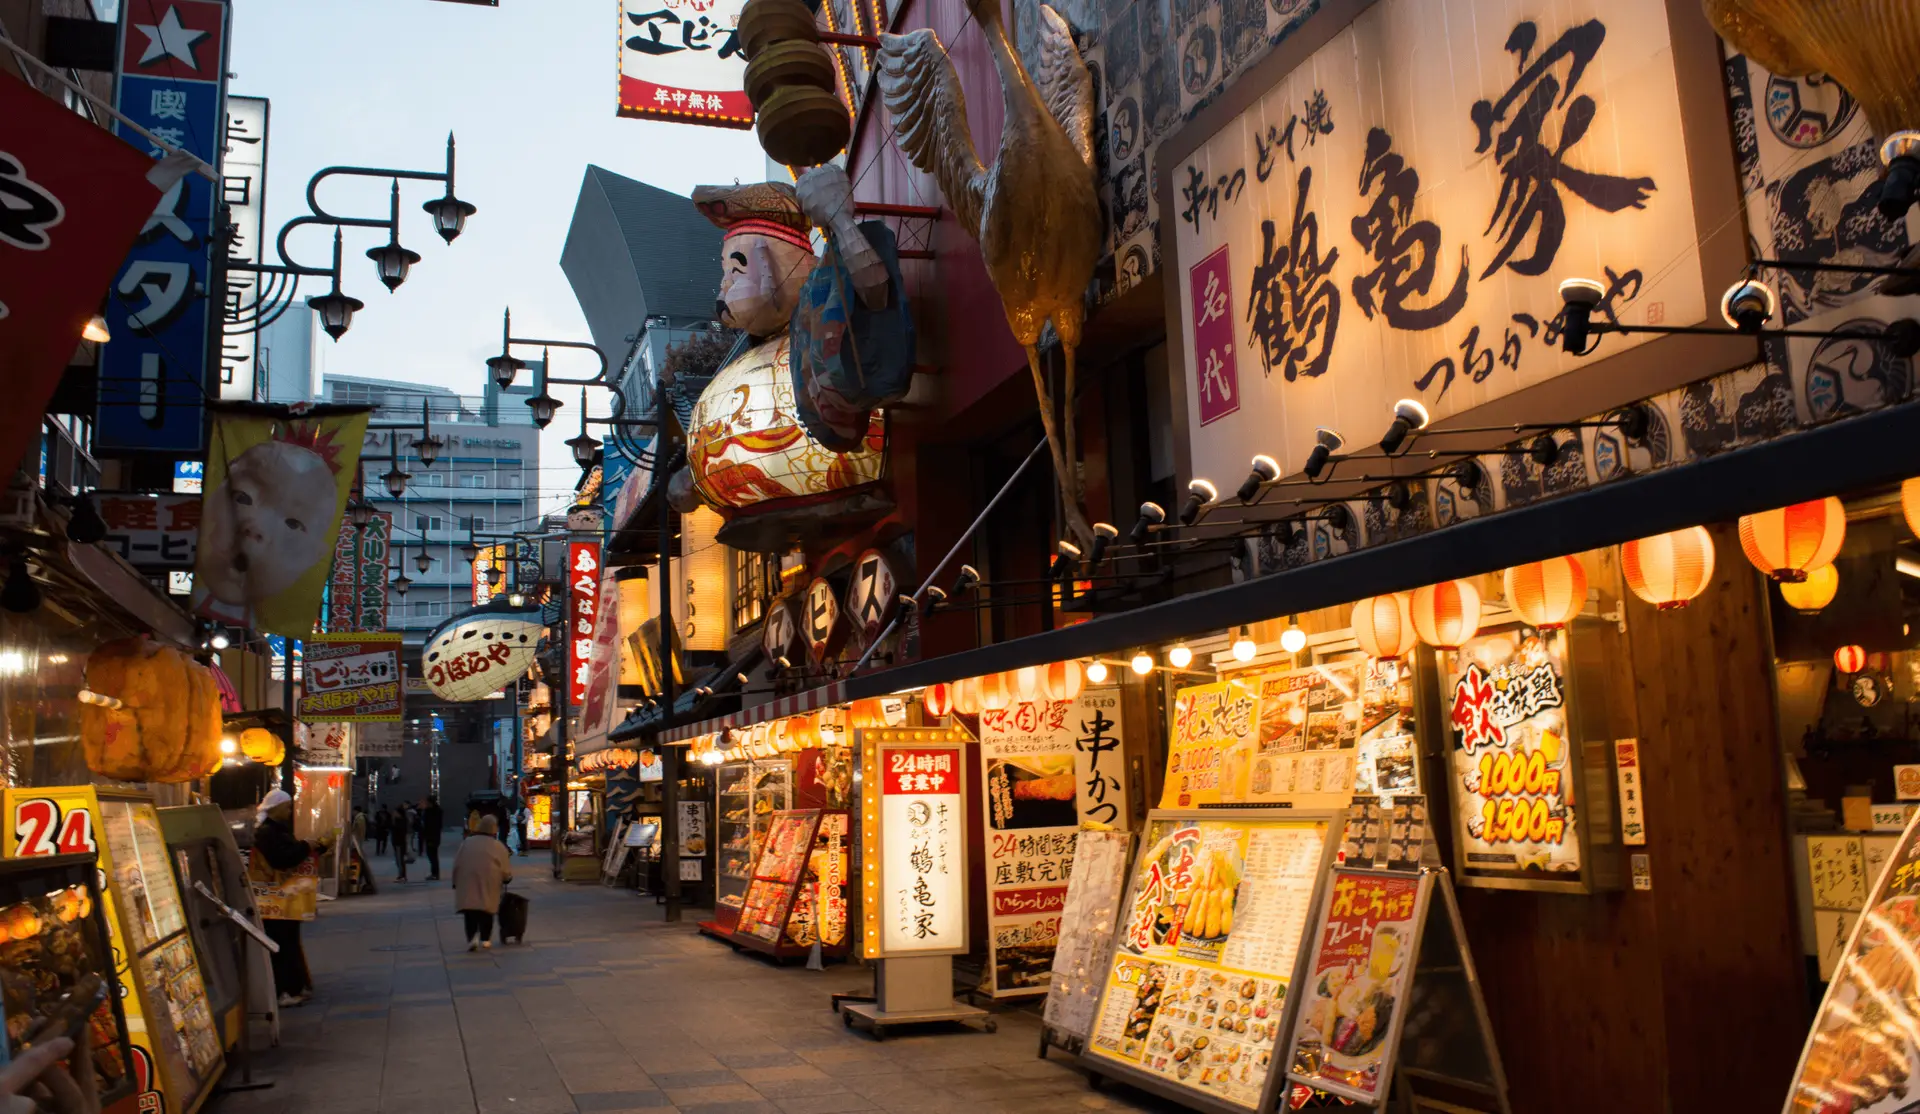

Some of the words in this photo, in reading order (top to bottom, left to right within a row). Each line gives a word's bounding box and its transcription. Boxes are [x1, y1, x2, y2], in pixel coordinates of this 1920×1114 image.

[626, 9, 749, 62] エビス
[653, 88, 724, 111] 年中無休
[1181, 165, 1246, 235] 串かつ
[1248, 18, 1658, 382] 鶴亀家
[1198, 269, 1233, 403] 名代
[104, 534, 196, 561] コーヒ
[312, 660, 371, 688] ビリーズ
[427, 641, 511, 687] づぼらや
[303, 683, 398, 712] 大阪みやげ
[1452, 662, 1564, 756] 飲み放題
[891, 754, 951, 773] 24時間
[898, 775, 945, 791] 営業中
[1075, 709, 1121, 824] 串かつ
[15, 799, 96, 858] 24
[687, 803, 703, 833] 串かつ
[910, 840, 939, 940] 鶴亀家
[1331, 878, 1415, 919] おこちゃま
[1327, 918, 1373, 946] プレート
